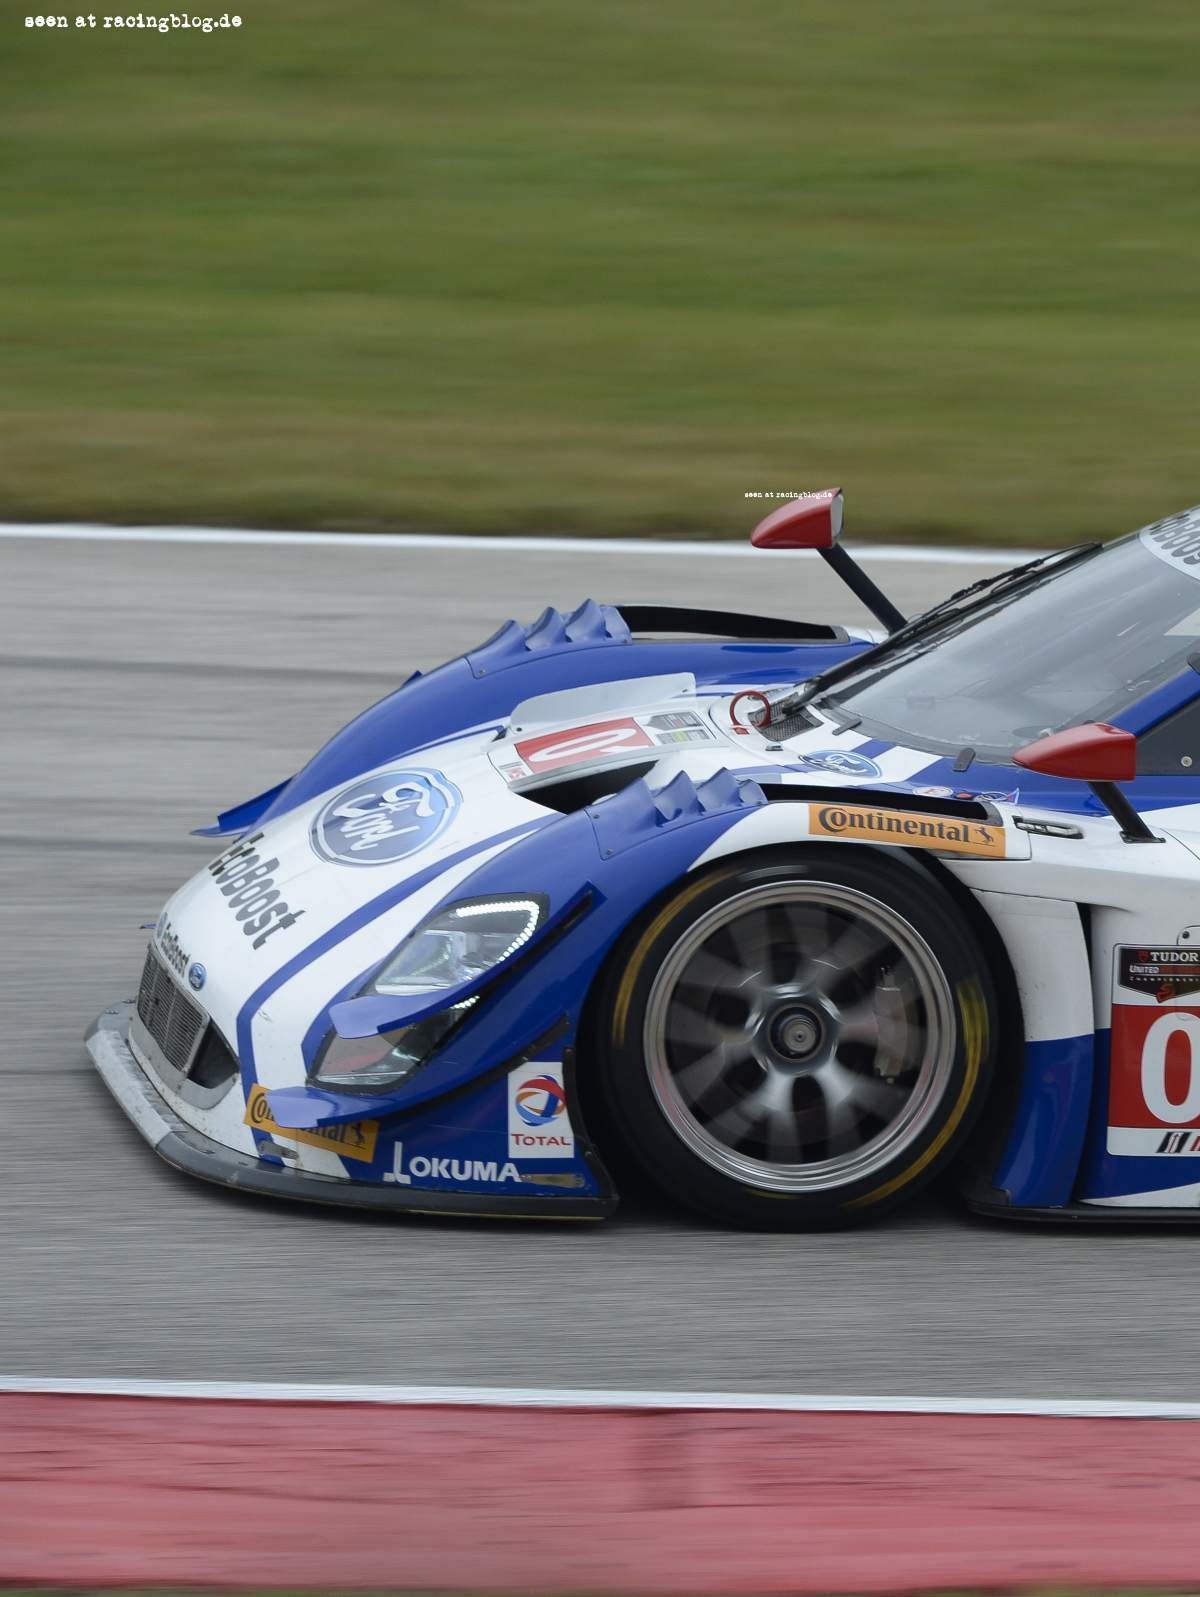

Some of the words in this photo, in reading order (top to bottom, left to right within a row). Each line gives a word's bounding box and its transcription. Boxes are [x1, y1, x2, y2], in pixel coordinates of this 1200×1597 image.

[331, 781, 436, 851] Ford
[818, 806, 969, 843] Continental
[1150, 951, 1200, 962] TUDOR
[511, 1132, 572, 1147] TOTAL
